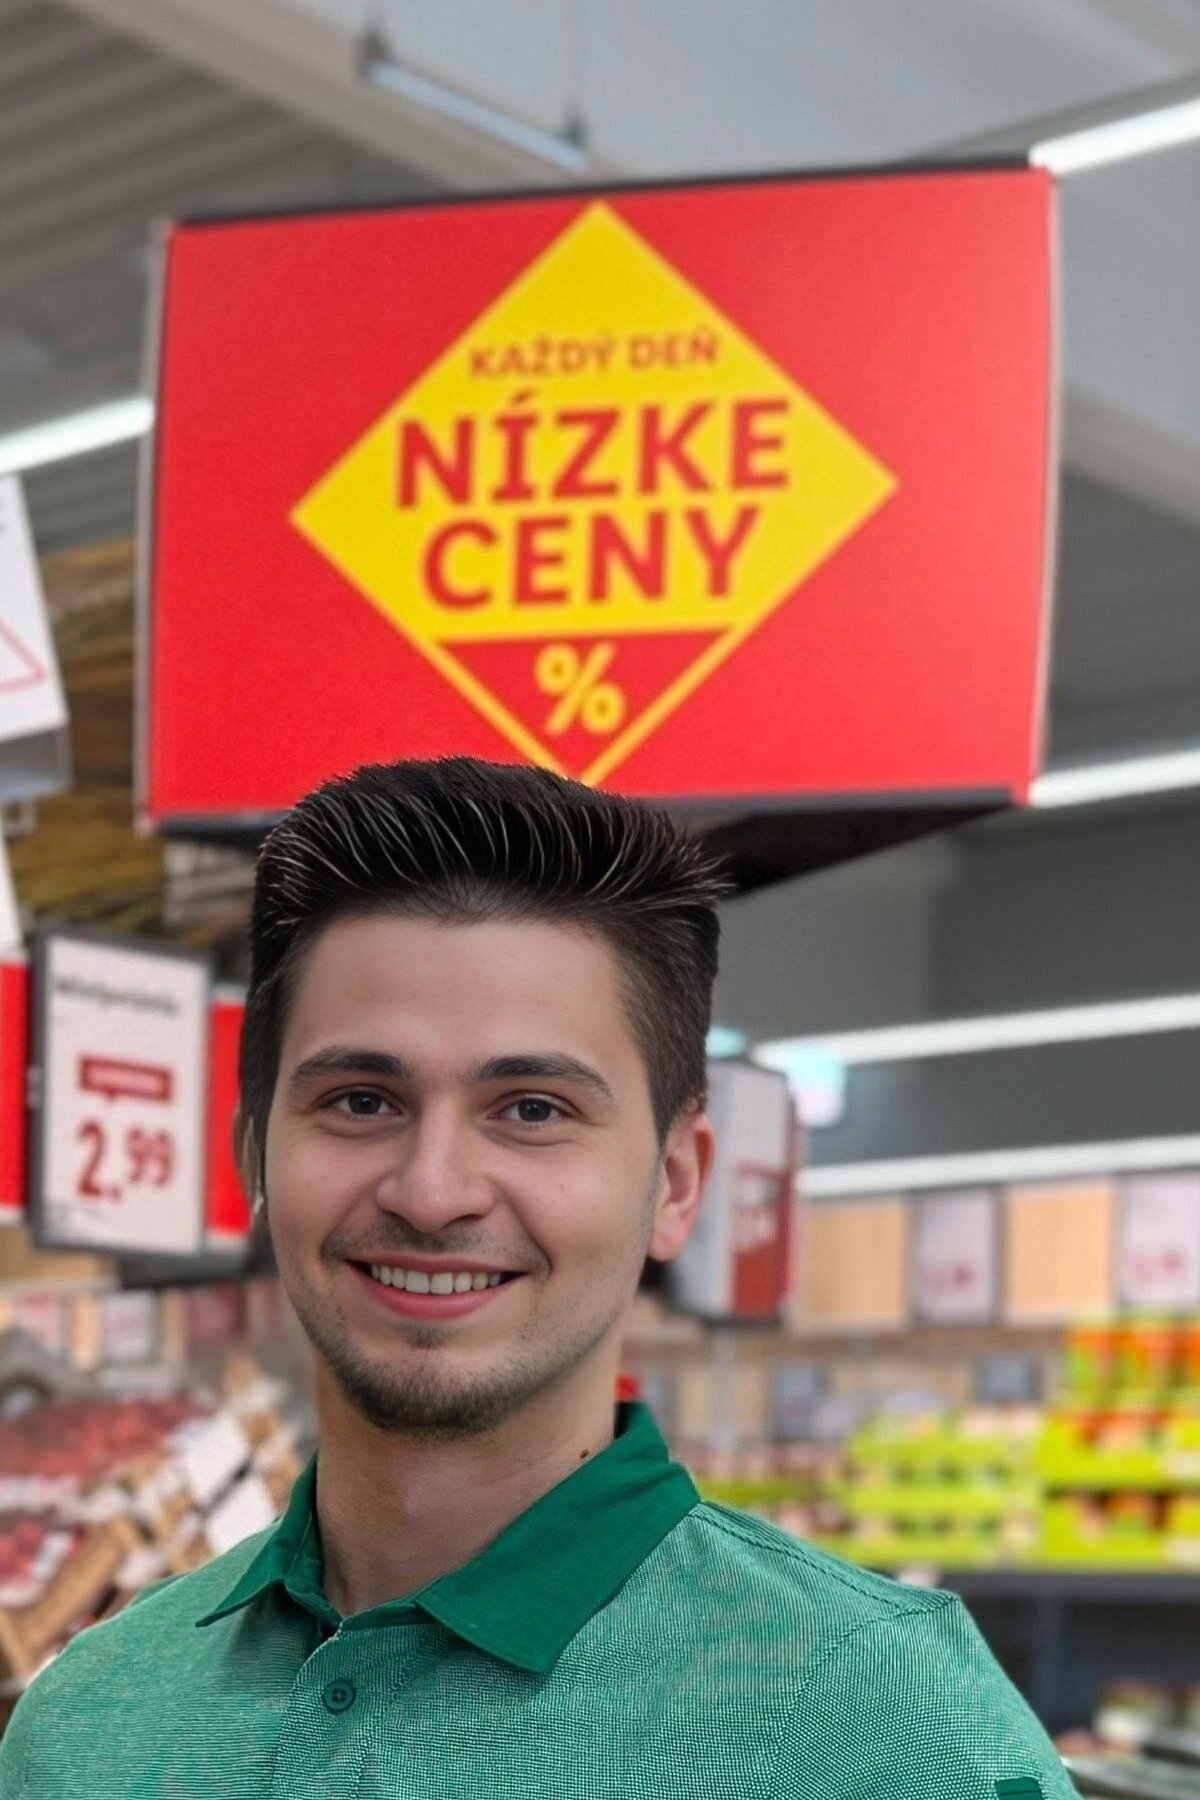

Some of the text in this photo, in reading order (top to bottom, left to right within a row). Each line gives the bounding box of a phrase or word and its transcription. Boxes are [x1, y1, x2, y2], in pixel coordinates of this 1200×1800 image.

[468, 325, 717, 379] KAŽDÝ DEŇ
[395, 388, 791, 511] NÍZKE
[420, 505, 760, 612] CENY
[534, 642, 625, 736] %
[76, 1117, 176, 1201] 2.99
